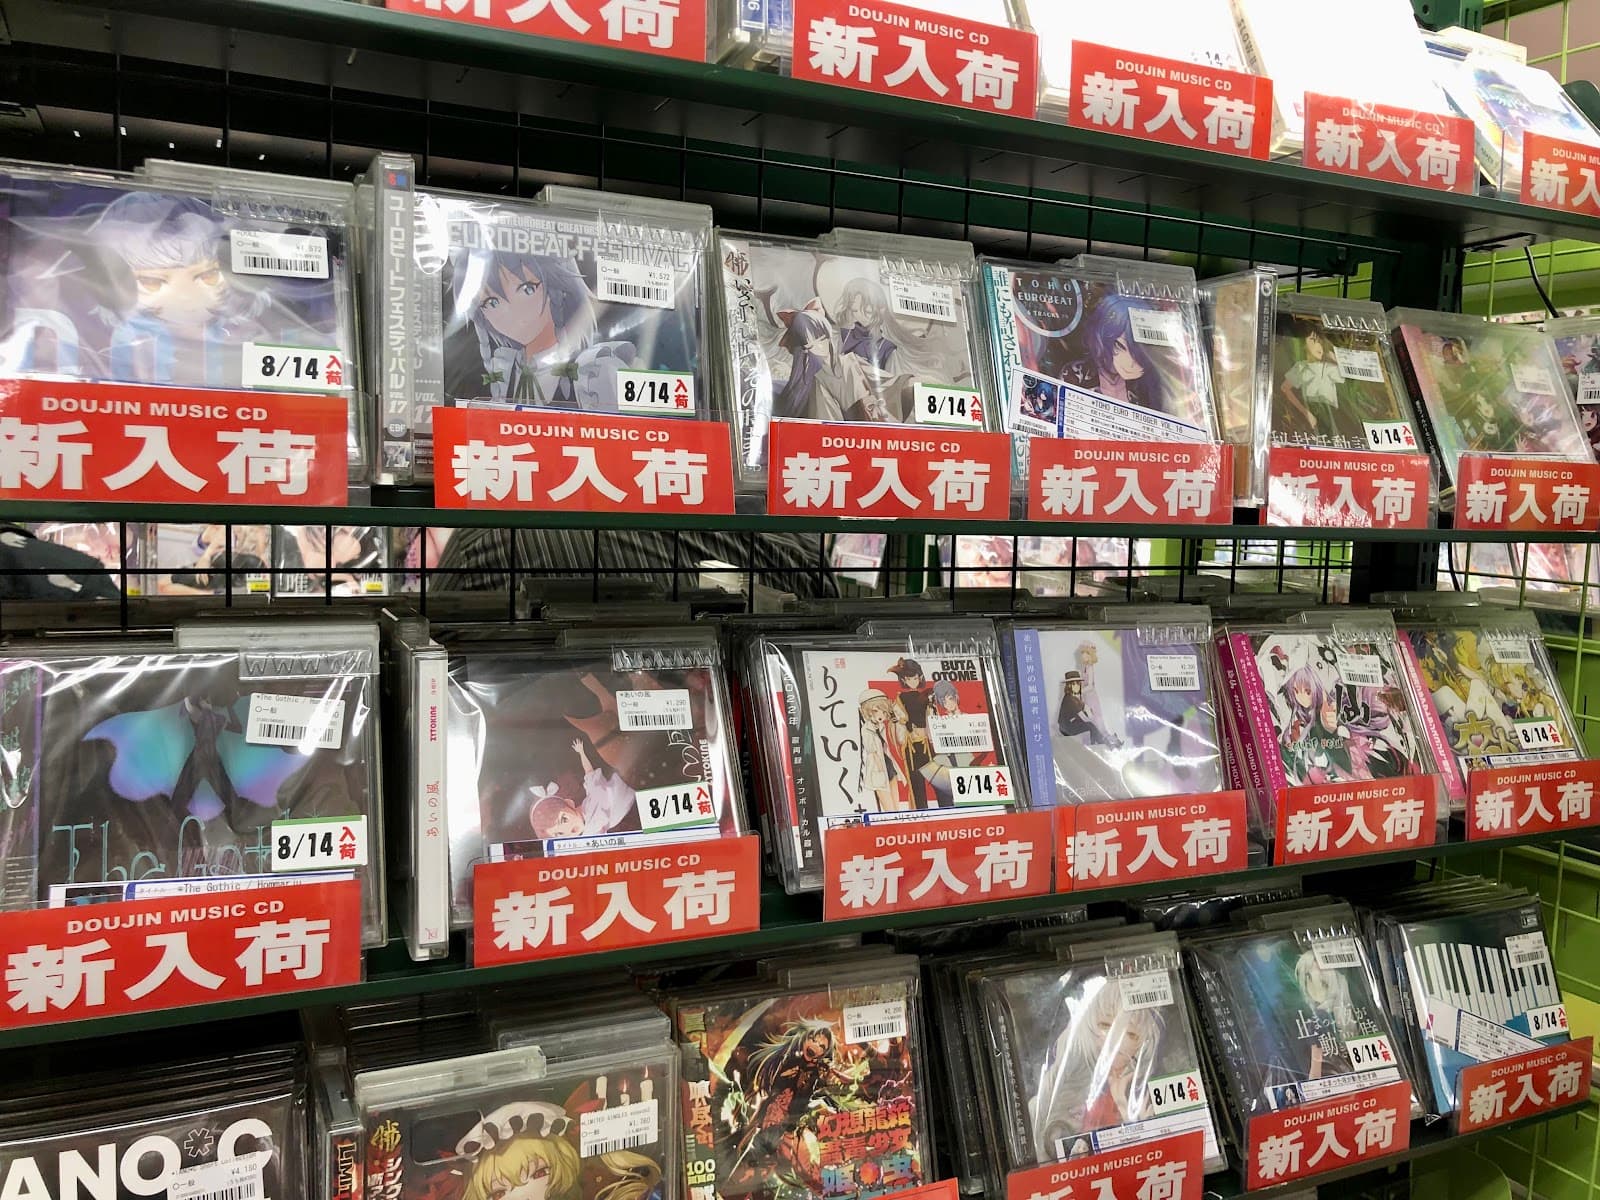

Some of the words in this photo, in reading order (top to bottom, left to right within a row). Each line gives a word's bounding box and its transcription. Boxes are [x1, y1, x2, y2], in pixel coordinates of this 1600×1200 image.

[849, 5, 910, 28] DOUJIN
[915, 20, 964, 40] MUSIC
[969, 33, 990, 46] CD
[808, 17, 1020, 110] 新入荷
[1115, 59, 1166, 79] DOUJIN
[1170, 70, 1211, 88] MUSIC
[1215, 79, 1232, 92] CD
[1082, 72, 1256, 150] 新入荷
[1315, 119, 1461, 185] 新入荷
[1552, 147, 1587, 162] DOUJIN
[1018, 292, 1073, 306] EUROBEAT
[261, 354, 319, 380] 8/14
[326, 355, 343, 385] 入荷
[624, 380, 670, 403] 8/14
[674, 379, 689, 409] 入荷
[42, 397, 141, 416] DOUJIN
[150, 402, 229, 419] MUSIC
[236, 406, 268, 421] CD
[927, 395, 966, 417] 8/14
[970, 396, 983, 421] 入荷
[500, 423, 573, 438] DOUJIN
[580, 427, 640, 441] MUSIC
[645, 430, 670, 443] CD
[822, 436, 882, 450] DOUJIN
[887, 439, 936, 453] MUSIC
[940, 443, 961, 454] CD
[1371, 428, 1401, 445] 8/14
[1402, 425, 1416, 447] 入荷
[0, 417, 316, 496] 新入荷
[1074, 450, 1125, 462] DOUJIN
[1129, 451, 1170, 463] MUSIC
[1174, 453, 1190, 464] CD
[1300, 459, 1341, 470] DOUJIN
[1344, 462, 1378, 473] MUSIC
[1380, 464, 1395, 473] CD
[451, 440, 708, 505] 新入荷
[782, 452, 991, 512] 新入荷
[1490, 468, 1527, 479] DOUJIN
[1529, 470, 1558, 480] MUSIC
[1560, 471, 1573, 480] CD
[1040, 464, 1216, 517] 新入荷
[1465, 480, 1590, 525] 新入荷
[932, 670, 978, 682] OTOME
[941, 659, 977, 672] BUTA
[1521, 727, 1549, 744] 8/14
[1548, 723, 1561, 744] 入荷
[1245, 743, 1258, 770] SOUND
[956, 774, 993, 795] 8/14
[995, 770, 1009, 797] 入荷
[1497, 774, 1532, 786] DOUJIN
[1534, 770, 1562, 782] MUSIC
[1564, 769, 1577, 779] CD
[649, 792, 693, 819] 8/14
[696, 786, 712, 815] 入荷
[1313, 793, 1354, 805] DOUJIN
[1357, 788, 1389, 800] MUSIC
[1392, 786, 1406, 797] CD
[1475, 780, 1594, 832] 新入荷
[1096, 810, 1145, 825] DOUJIN
[1147, 807, 1187, 820] MUSIC
[1190, 804, 1207, 815] CD
[1286, 798, 1425, 855] 新入荷
[277, 832, 333, 860] 8/14
[339, 826, 357, 860] 入荷
[875, 832, 932, 849] DOUJIN
[936, 828, 982, 842] MUSIC
[986, 825, 1005, 837] CD
[1065, 818, 1231, 881] 新入荷
[538, 863, 609, 882] DOUJIN
[615, 857, 672, 875] MUSIC
[677, 854, 701, 868] CD
[839, 840, 1033, 909] 新入荷
[206, 880, 241, 892] Gothic
[67, 912, 162, 934] DOUJIN
[170, 906, 247, 924] MUSIC
[253, 900, 285, 915] CD
[492, 870, 736, 951] 新入荷
[5, 917, 331, 1014] 新入荷
[1533, 1011, 1558, 1031] 8/14
[1557, 1007, 1568, 1028] 入荷
[1352, 1043, 1380, 1064] 8/14
[1378, 1039, 1392, 1063] 入荷
[1491, 1062, 1525, 1079] DOUJIN
[1526, 1056, 1554, 1070] MUSIC
[1555, 1052, 1568, 1062] CD
[1153, 1082, 1186, 1106] 8/14
[1186, 1076, 1200, 1101] 入荷
[1468, 1061, 1584, 1124] 新入荷
[1284, 1111, 1325, 1128] DOUJIN
[1327, 1103, 1360, 1118] MUSIC
[1362, 1098, 1377, 1108] CD
[1257, 1108, 1397, 1180] 新入荷
[687, 1159, 716, 1175] 100
[1051, 1164, 1100, 1185] DOUJIN
[1103, 1156, 1143, 1176] MUSIC
[1146, 1150, 1163, 1163] CD
